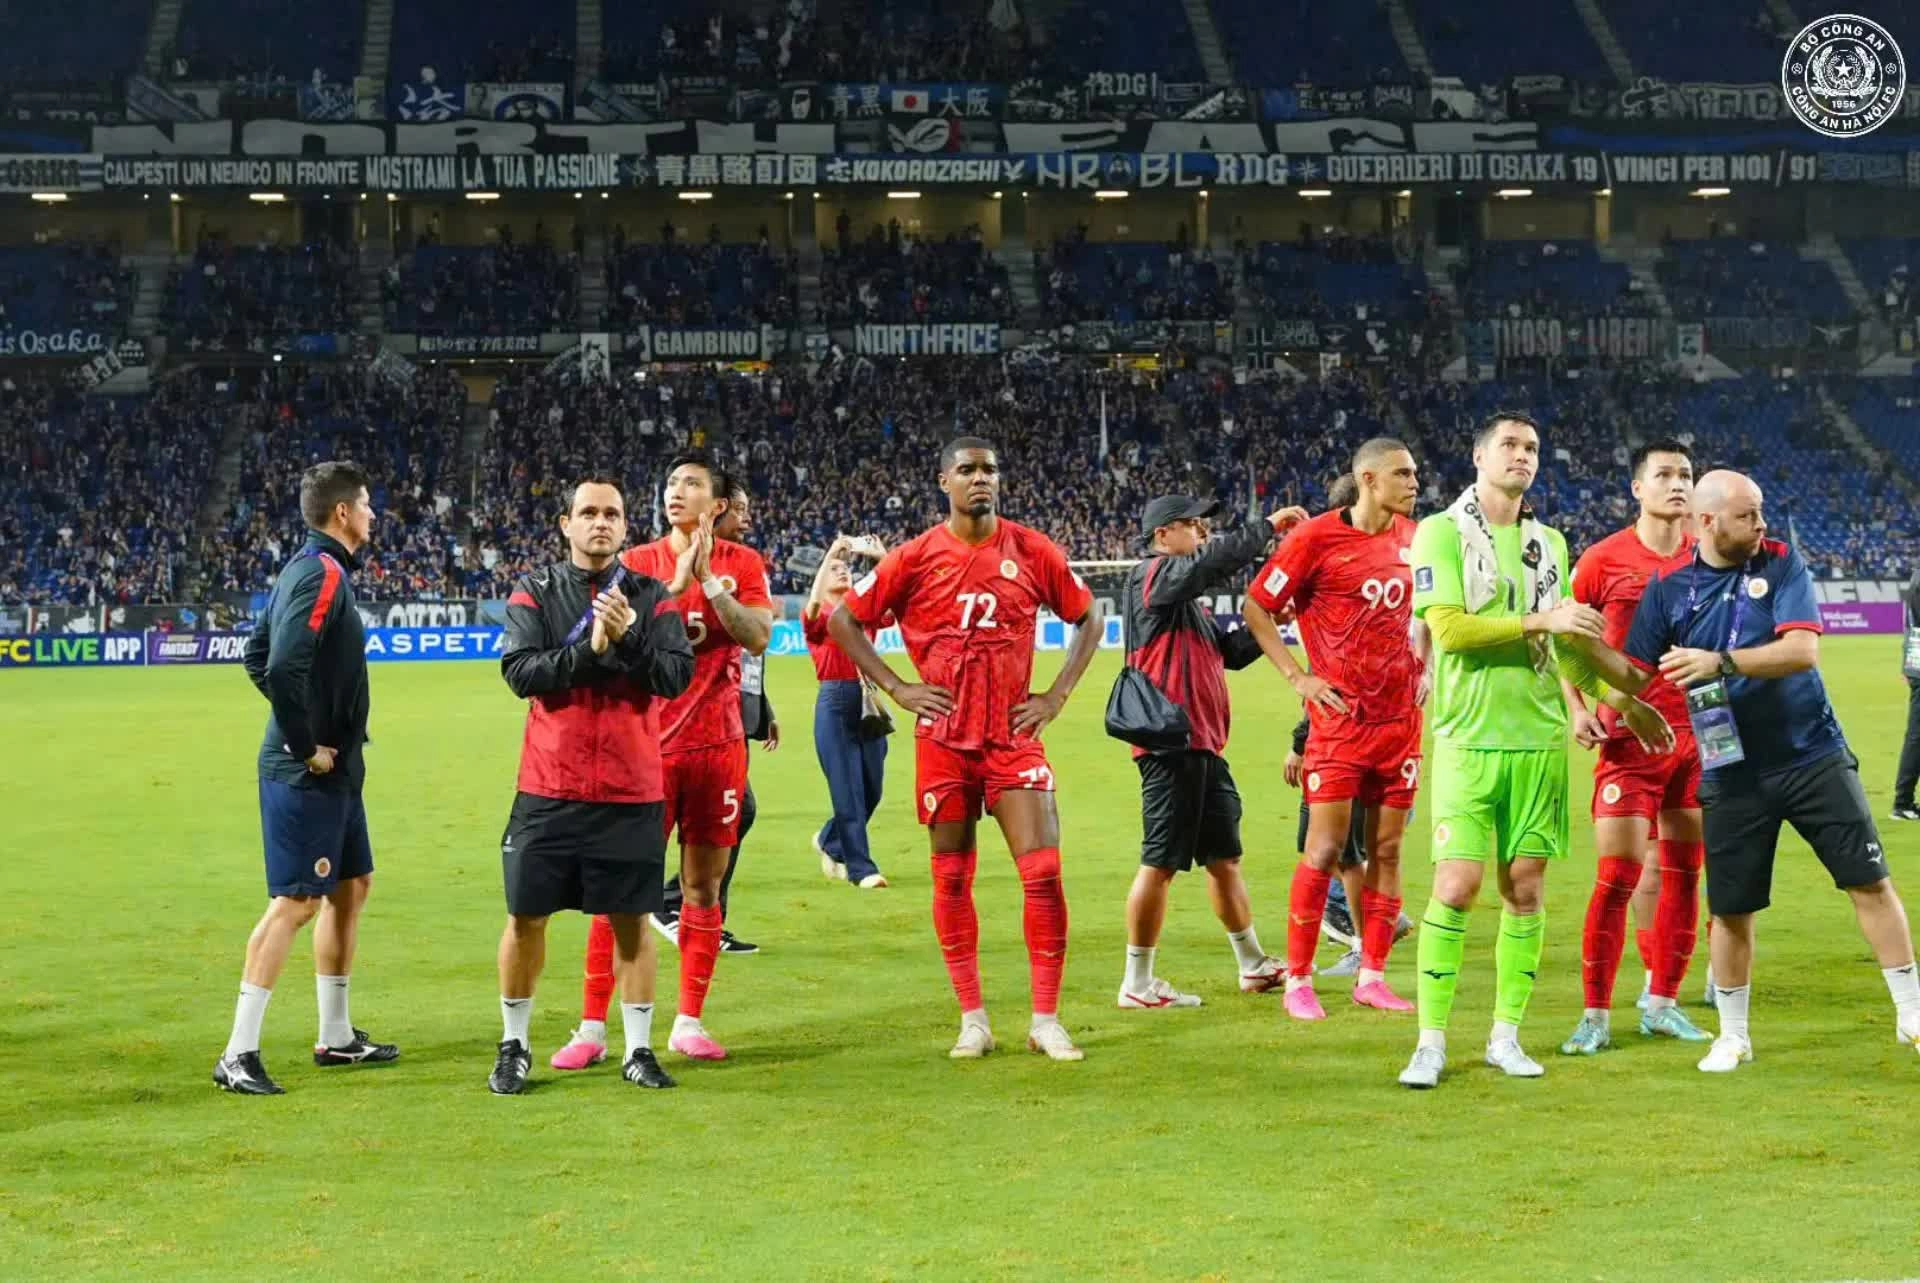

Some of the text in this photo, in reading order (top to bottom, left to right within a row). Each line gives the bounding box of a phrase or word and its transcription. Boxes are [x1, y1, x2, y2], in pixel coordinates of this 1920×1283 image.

[936, 87, 991, 117] 大阪
[104, 160, 359, 185] CALPESTI UN NEMICO IN FRONTE
[365, 153, 621, 189] MOSTRAMI LA TUA PASSIONE
[852, 159, 1000, 182] KOKOROZASHI
[1215, 153, 1288, 185] RDG
[1327, 153, 1566, 183] GUERRIERI DI OSAKA
[1571, 156, 1598, 181] 19
[1614, 156, 1678, 182] VINCI
[1683, 156, 1726, 181] PER
[1731, 155, 1770, 180] NOI
[1790, 155, 1816, 181] 91
[18, 328, 104, 355] Osaka
[654, 330, 758, 355] GAMBINO
[855, 322, 1000, 355] NORTHFACE
[1361, 577, 1405, 610] 90
[956, 592, 998, 629] 72
[687, 611, 707, 647] 5
[35, 637, 100, 662] LIVE
[104, 637, 142, 661] APP
[1400, 758, 1421, 789] 9
[722, 788, 739, 824] 5
